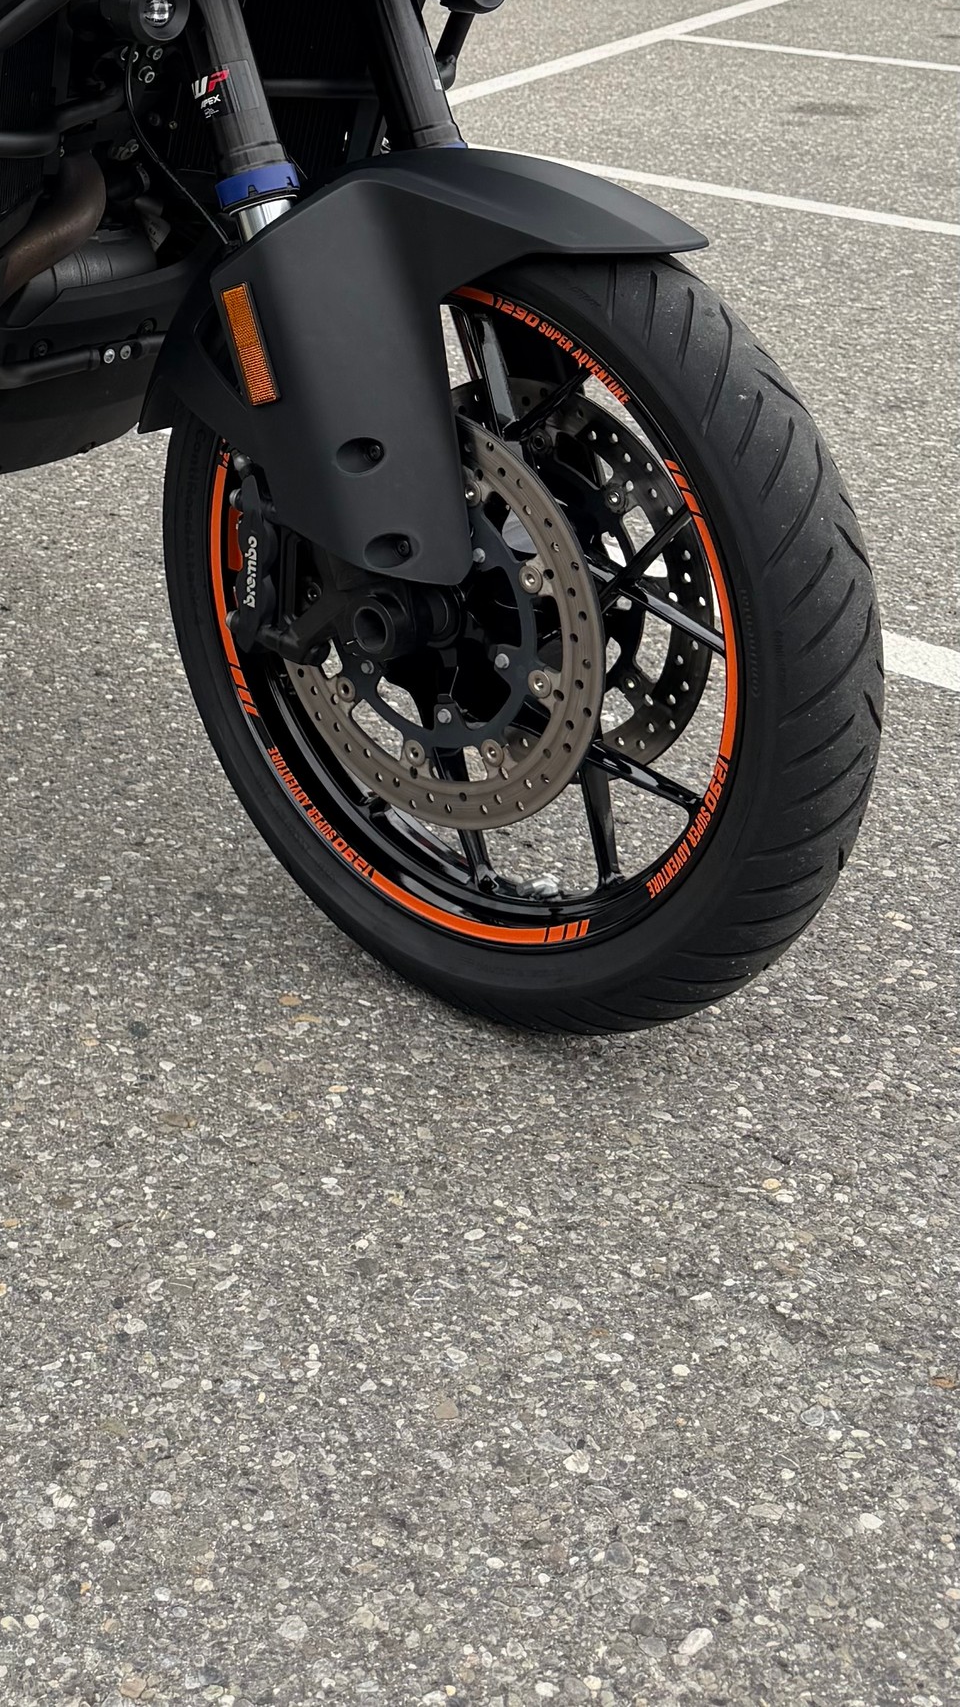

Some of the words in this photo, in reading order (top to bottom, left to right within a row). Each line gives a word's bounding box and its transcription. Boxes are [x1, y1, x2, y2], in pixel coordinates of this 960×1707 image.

[495, 296, 540, 329] 1290
[538, 321, 574, 352] SUPER
[571, 348, 632, 406] ADVENTURE
[243, 535, 258, 609] brembo
[267, 746, 313, 807] ADVENTURE
[704, 757, 729, 813] 1290
[306, 806, 337, 840] SUPER
[686, 806, 711, 848] SUPER
[332, 837, 374, 877] 1290
[645, 839, 691, 899] ADVENTURE
